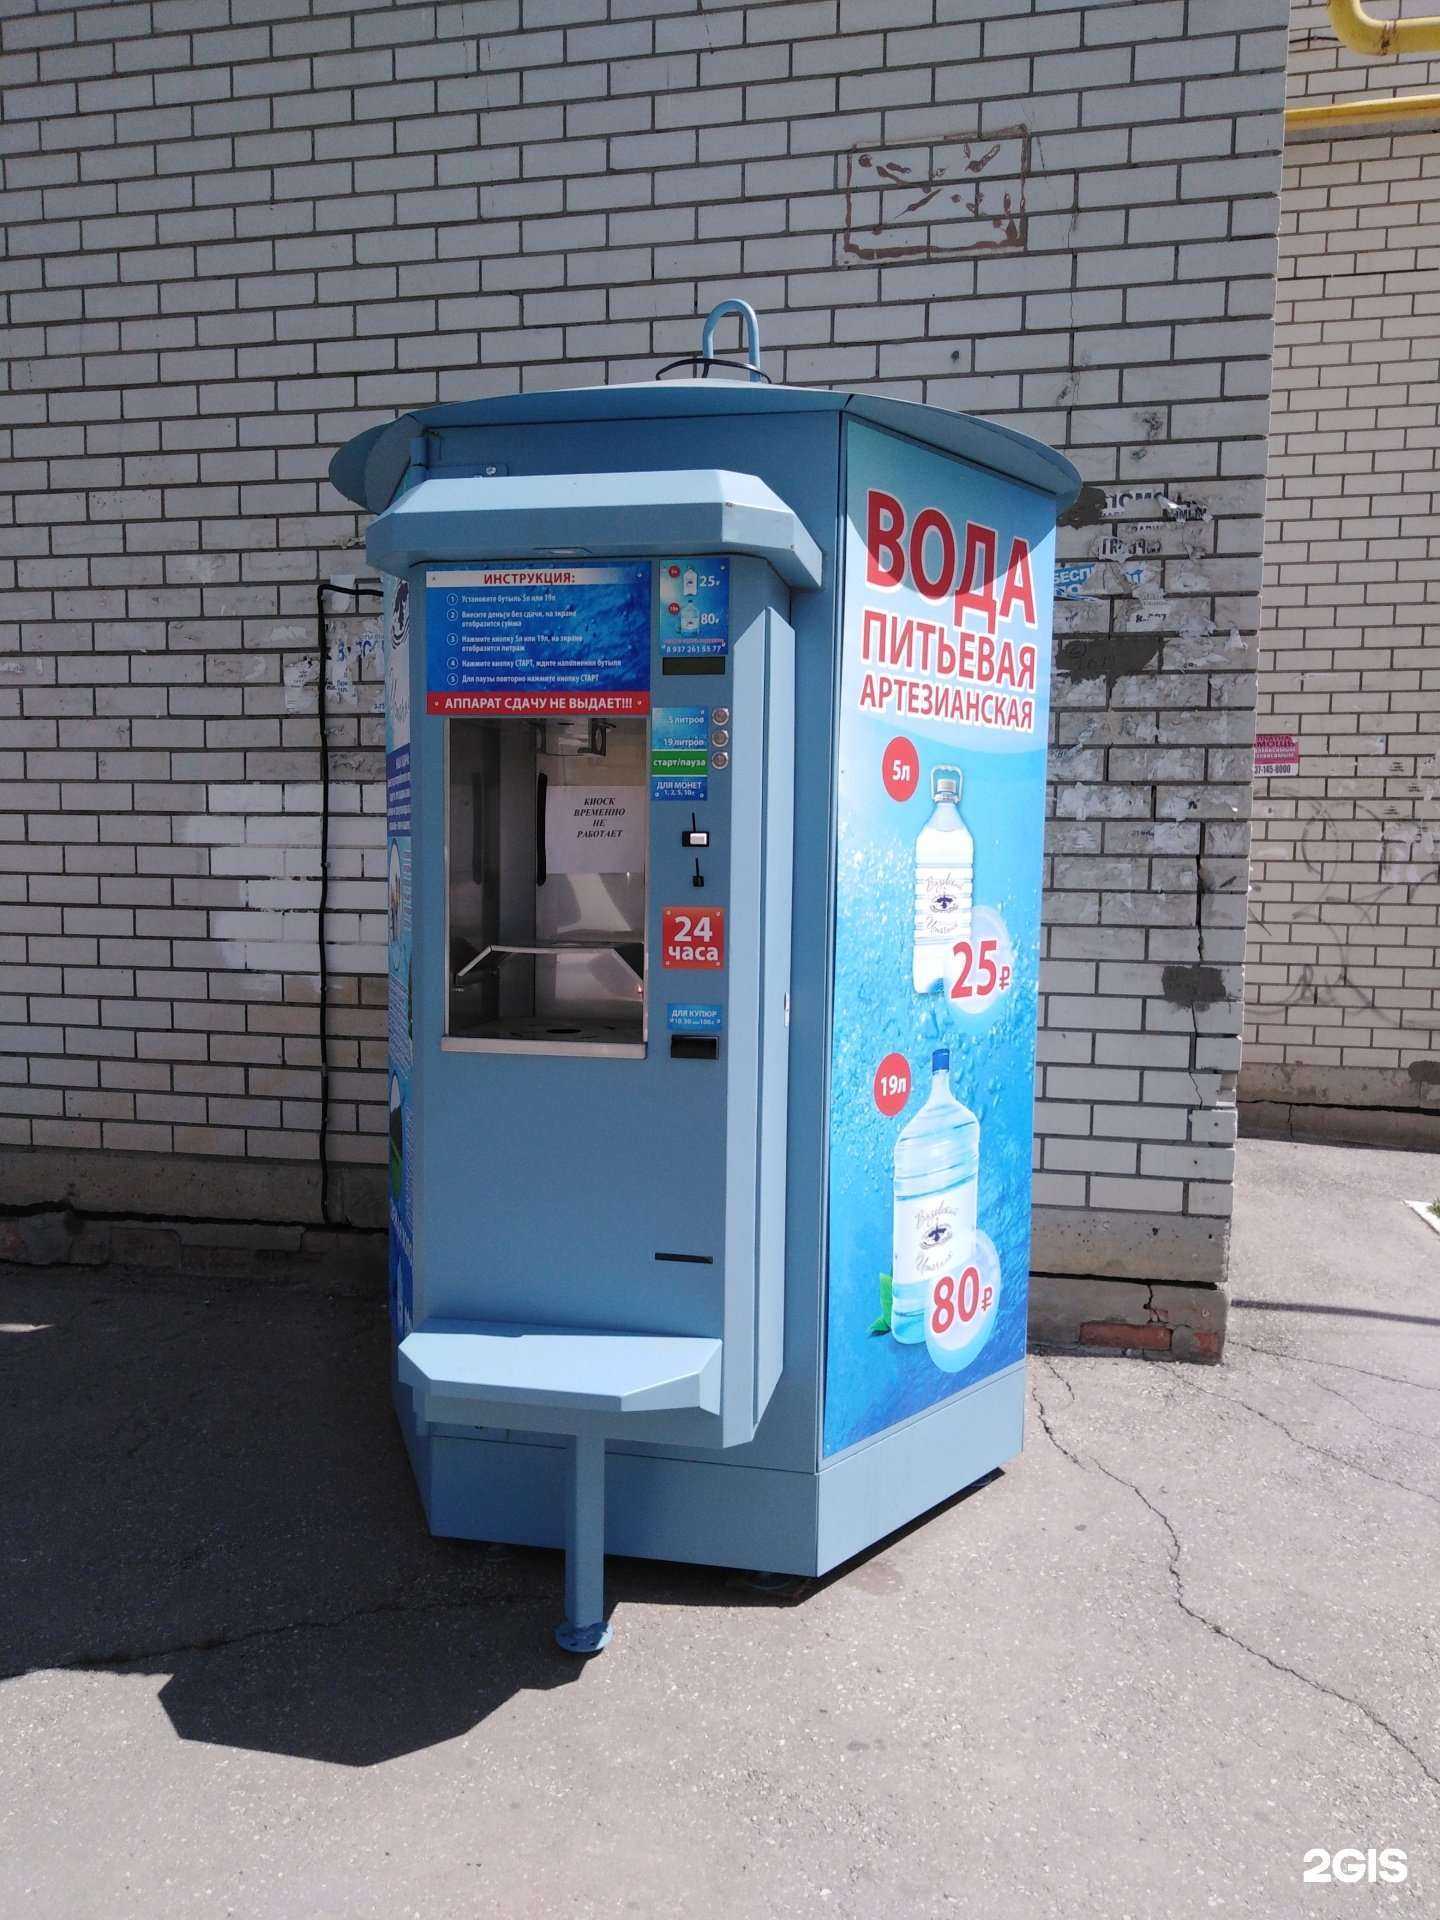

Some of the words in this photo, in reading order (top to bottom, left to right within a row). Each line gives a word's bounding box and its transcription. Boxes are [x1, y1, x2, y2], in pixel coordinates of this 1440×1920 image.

[866, 490, 1036, 635] ВОДА
[484, 572, 576, 585] ИНСТРУКЦИЯ:
[498, 594, 520, 605] бутыль
[531, 594, 544, 602] или
[461, 610, 487, 619] Внесите
[488, 611, 510, 620] деньги
[511, 610, 522, 618] без
[546, 610, 554, 618] на
[555, 610, 577, 619] экране
[461, 620, 500, 629] отобразится
[501, 621, 522, 629] сумма
[461, 635, 491, 643] Нажмите
[492, 635, 514, 644] кнопку
[560, 634, 583, 643] экране
[461, 645, 501, 654] отобразится
[501, 645, 526, 653] литраж
[862, 610, 1036, 690] ПИТЬЕВАЯ
[492, 660, 514, 668] кнопку
[536, 660, 556, 668] ждите
[557, 659, 597, 667] наполнения
[598, 658, 622, 668] бутыли
[461, 674, 475, 683] Для
[475, 675, 495, 684] паузы
[496, 675, 526, 684] повторно
[527, 675, 555, 683] нажмите
[556, 675, 580, 684] кнопку
[580, 673, 599, 682] СТАРТ
[444, 698, 502, 710] АППАРАТ
[504, 698, 547, 712] СДАЧУ
[550, 697, 567, 710] НЕ
[569, 697, 633, 710] ВЫДАЕТ!!!
[860, 674, 1033, 729] АРТЕЗИАНСКАЯ
[674, 716, 705, 725] литров
[663, 738, 674, 746] 19
[674, 738, 705, 748] литров
[653, 758, 706, 768] старт/пауза
[891, 759, 911, 781] 5л
[656, 781, 673, 790] ДЛЯ
[674, 781, 702, 789] МОНЕТ
[583, 797, 616, 806] КИОСК
[573, 807, 626, 817] ВРЕМЕННО
[592, 819, 608, 827] НЕ
[577, 829, 624, 839] РАБОТАЕТ
[673, 915, 713, 943] 24
[668, 946, 719, 961] часа
[671, 1009, 688, 1018] ДЛЯ
[688, 1009, 718, 1018] КУПЮР
[880, 1074, 907, 1096] 19л
